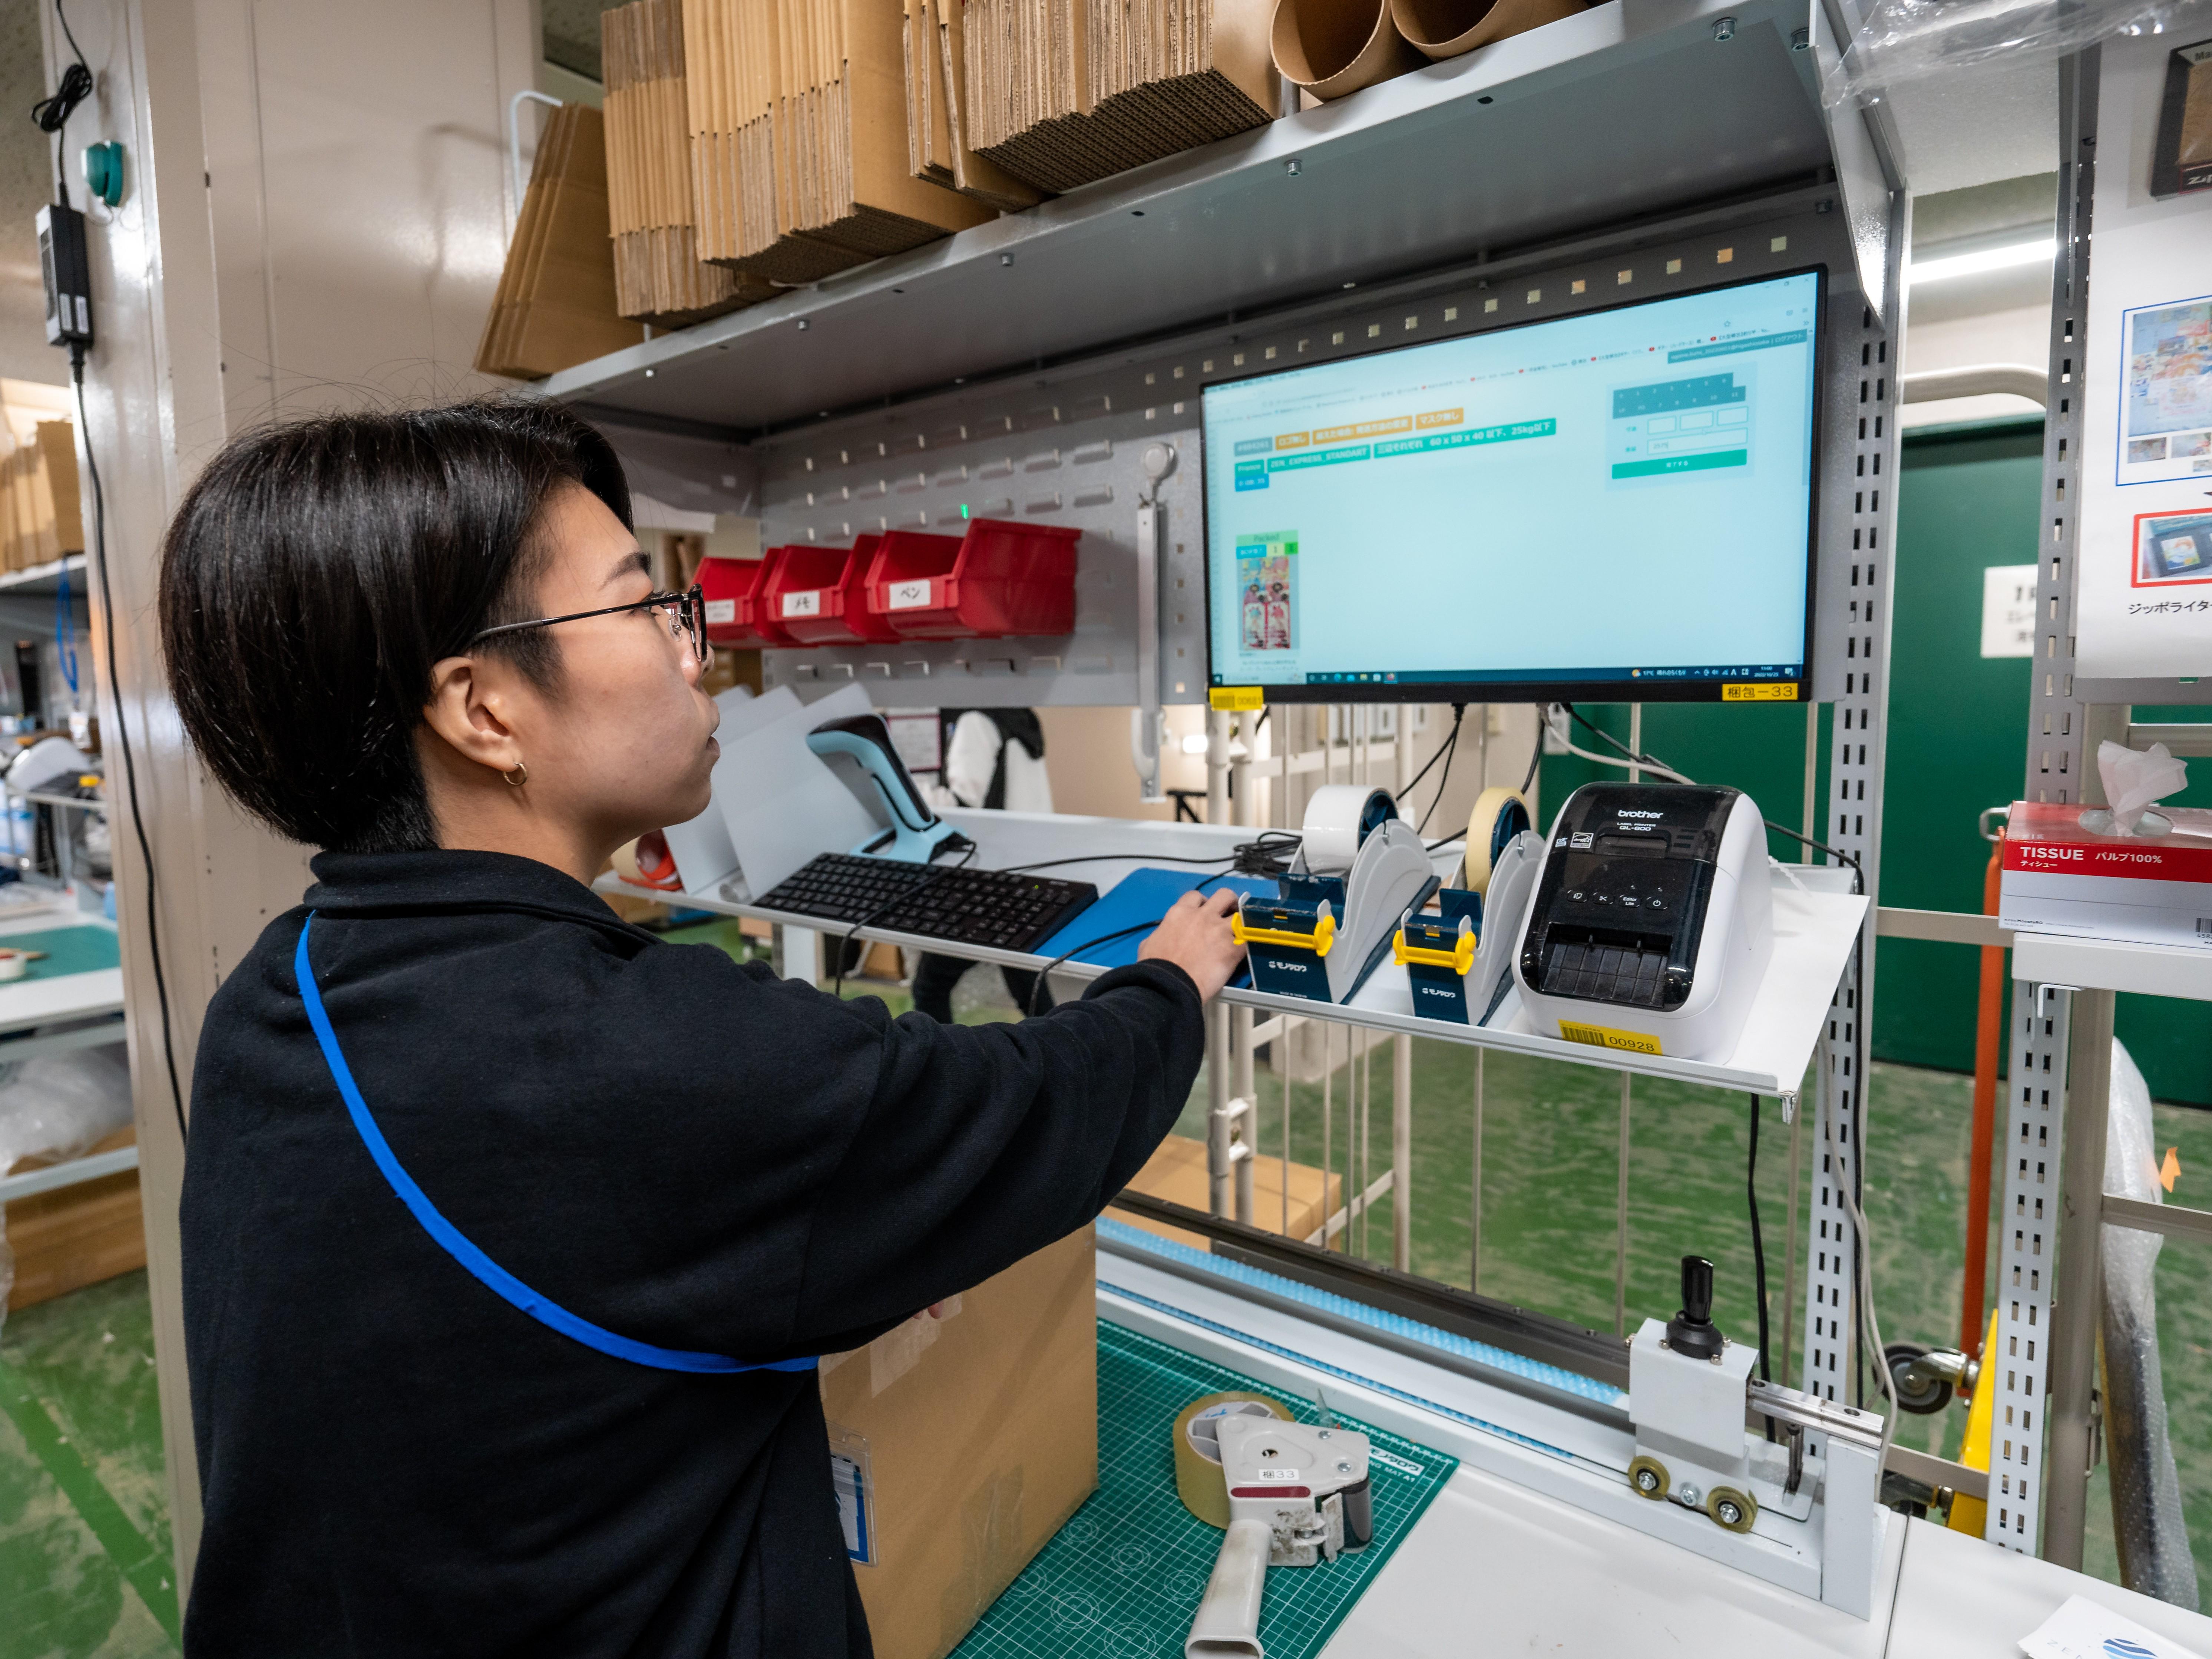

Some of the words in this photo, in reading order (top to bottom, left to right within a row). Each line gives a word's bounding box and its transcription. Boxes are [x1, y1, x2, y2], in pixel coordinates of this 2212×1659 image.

[1430, 438, 1441, 446] 60
[1451, 435, 1462, 443] 50
[1472, 432, 1484, 440] 40
[900, 586, 921, 600] ペン
[794, 596, 810, 610] メモ
[1617, 809, 1664, 819] brother
[2020, 846, 2084, 860] TISSUE
[2095, 852, 2162, 863] パルプ100%
[1276, 961, 1307, 972] モノタロウ
[1429, 988, 1456, 998] モノタロウ
[1609, 1036, 1655, 1052] 00928
[1262, 1470, 1295, 1479] 梱33
[1384, 1467, 1402, 1478] MAT
[1403, 1474, 1415, 1483] A1
